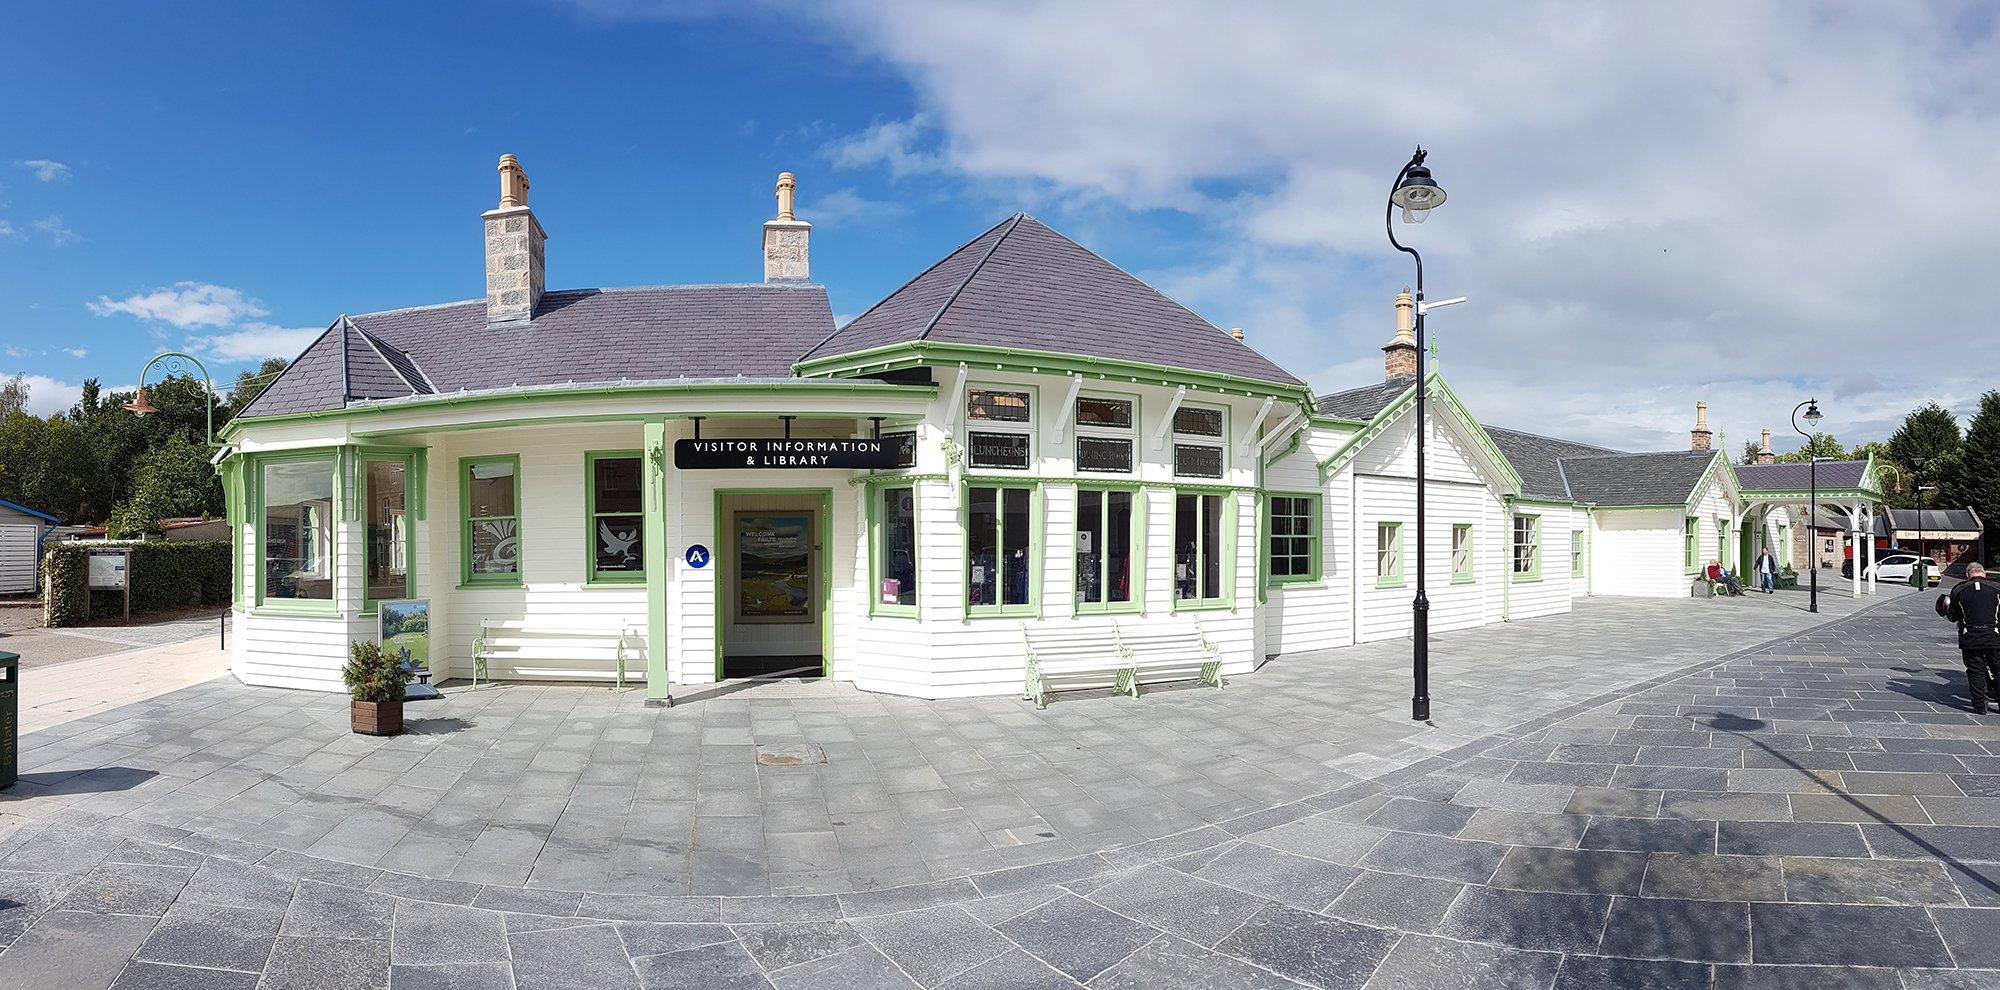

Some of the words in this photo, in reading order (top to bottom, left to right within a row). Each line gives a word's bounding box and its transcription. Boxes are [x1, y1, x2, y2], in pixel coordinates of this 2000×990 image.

[693, 442, 758, 452] VISITOR
[766, 442, 881, 452] INFORMATION
[973, 445, 1026, 457] LUNCHEONS
[1081, 450, 1107, 460] DNING
[746, 456, 755, 465] &
[764, 456, 828, 466] LIBRARY
[3, 711, 13, 766] Ballater
